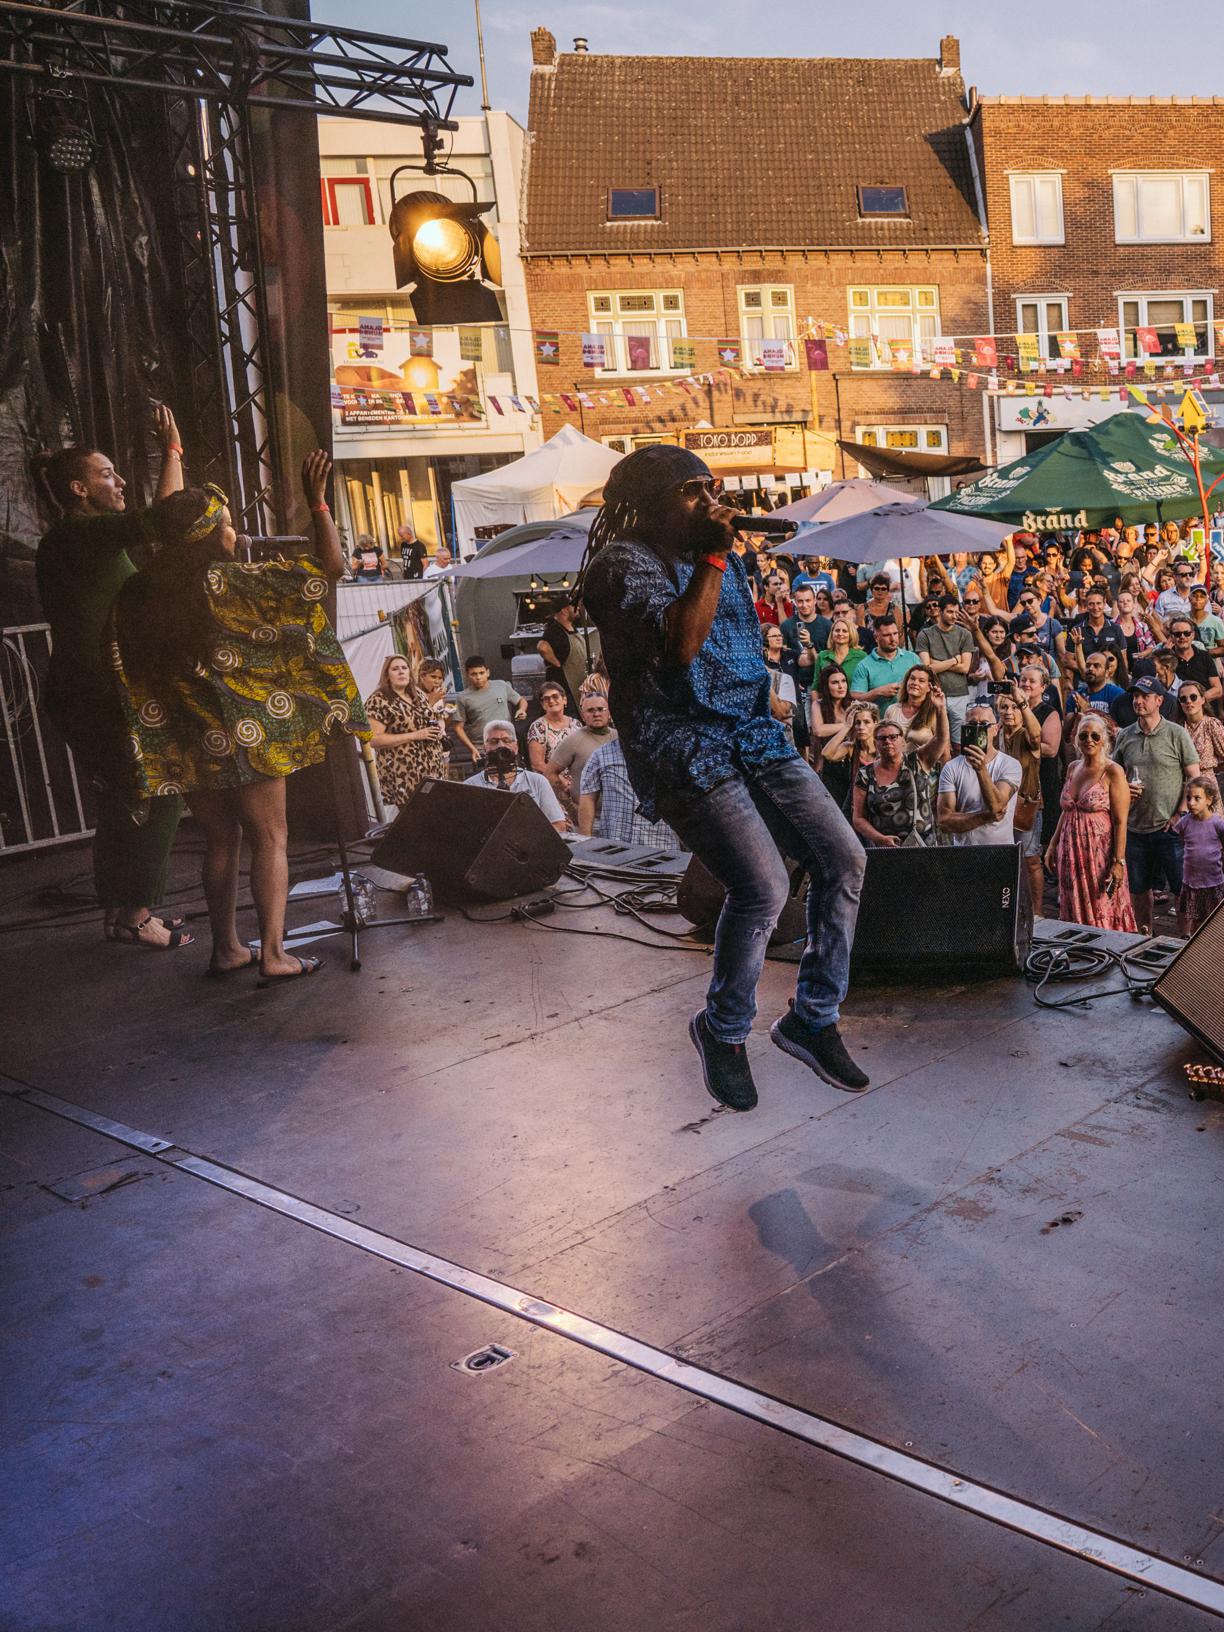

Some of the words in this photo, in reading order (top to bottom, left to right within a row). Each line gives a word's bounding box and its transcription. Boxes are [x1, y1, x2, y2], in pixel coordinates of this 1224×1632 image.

[700, 434, 728, 448] TOKO
[1022, 509, 1089, 532] Brand
[1002, 887, 1011, 908] NEXO
